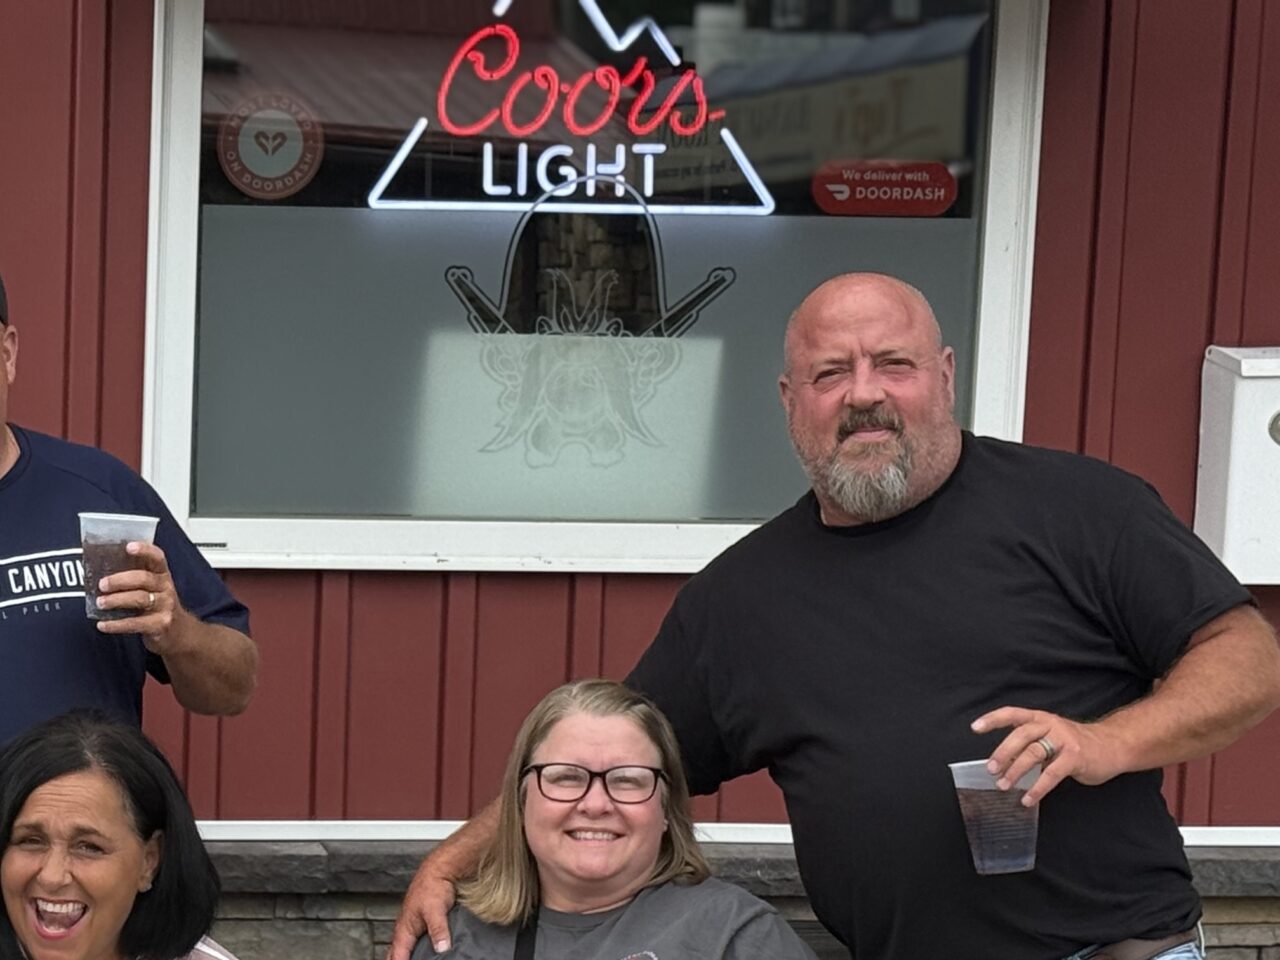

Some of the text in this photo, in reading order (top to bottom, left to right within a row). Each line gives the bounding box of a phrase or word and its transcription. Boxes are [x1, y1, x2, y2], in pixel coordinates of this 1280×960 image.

[437, 24, 726, 136] Coors
[226, 151, 313, 191] ON DOORDASH
[482, 142, 667, 197] LIGHT
[842, 169, 930, 182] We deliver with
[855, 187, 946, 200] DOORDASH
[23, 602, 61, 615] PARK
